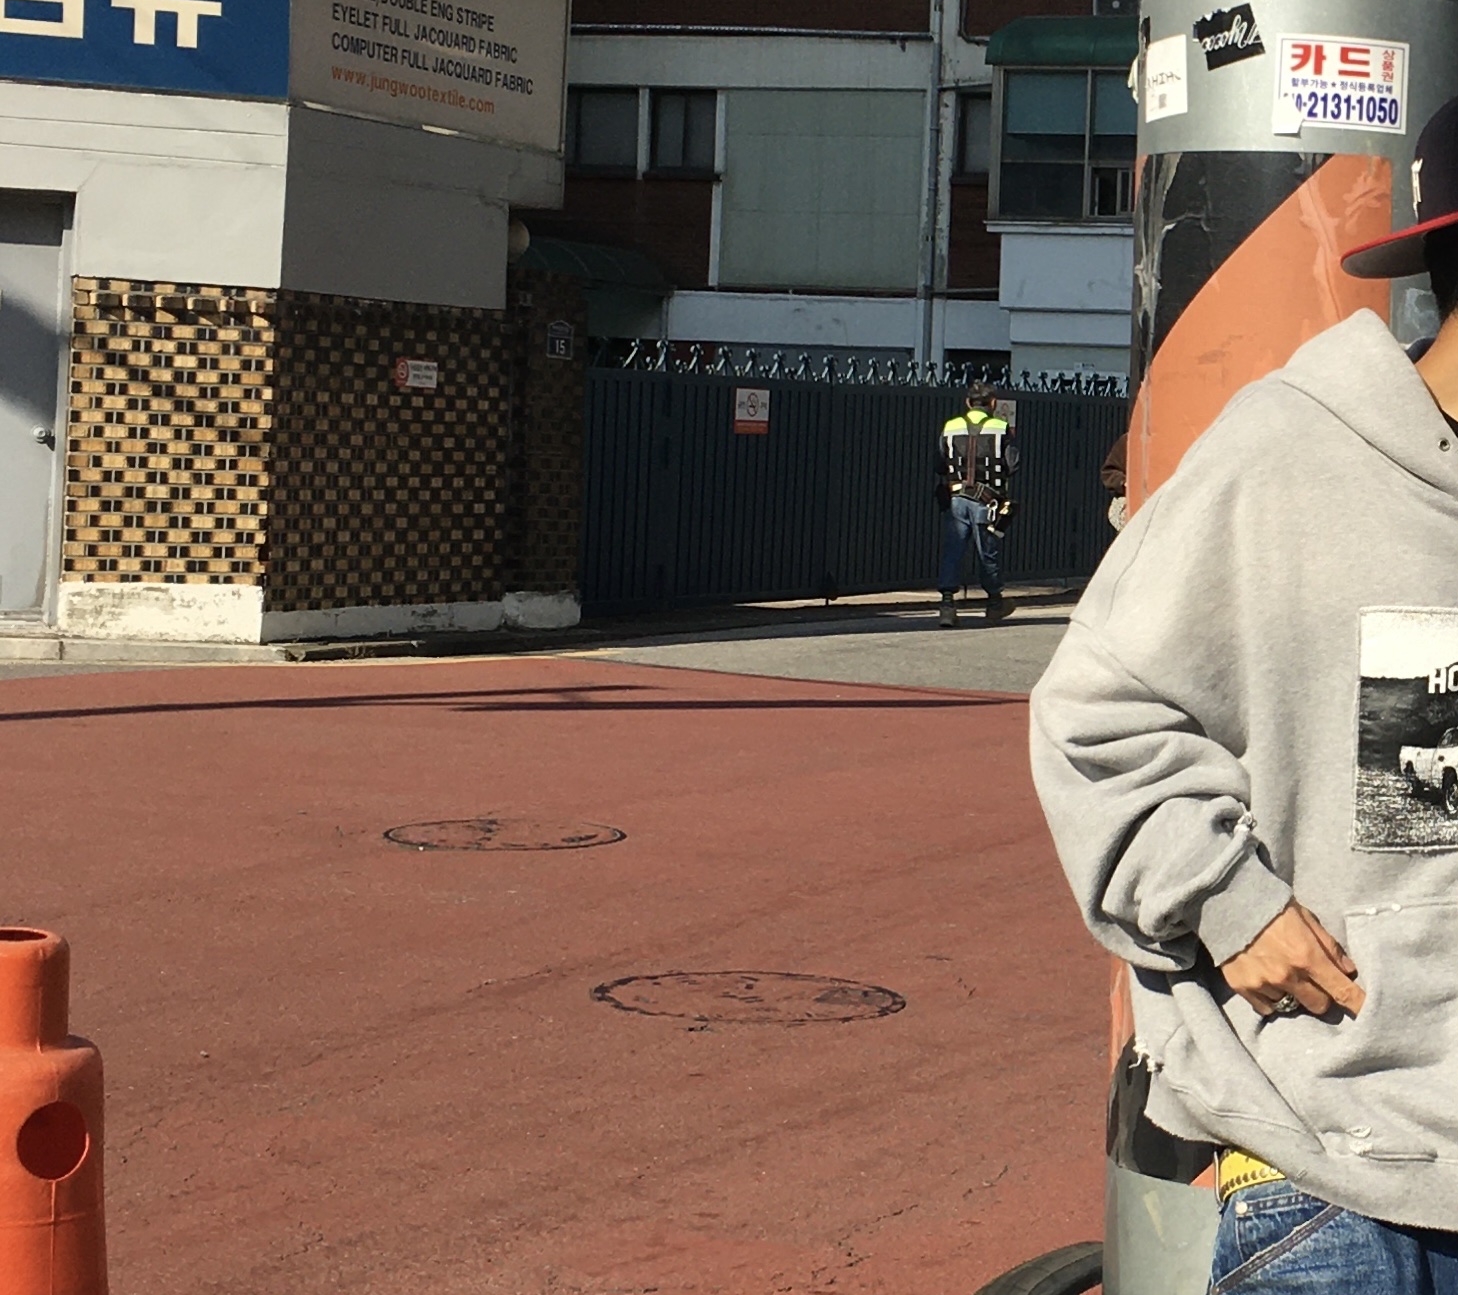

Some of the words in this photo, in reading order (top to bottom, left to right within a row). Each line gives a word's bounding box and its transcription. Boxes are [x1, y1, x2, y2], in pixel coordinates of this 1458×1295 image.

[332, 2, 379, 30] EYELET
[382, 15, 410, 38] FULL
[414, 24, 476, 54] JACQUARD
[479, 39, 518, 64] FABRIC
[431, 0, 453, 22] ENG
[456, 8, 494, 33] STRIPE
[332, 32, 399, 64] COMPUTER
[401, 49, 429, 71] FULL
[432, 57, 493, 86] JACQUARD
[495, 71, 534, 95] FABRIC
[1290, 43, 1371, 78] 카드
[331, 65, 495, 114] www.jungwootextile.com
[1291, 77, 1328, 89] 할부가능
[1339, 81, 1393, 95] 정식등록업체
[555, 339, 566, 355] 15
